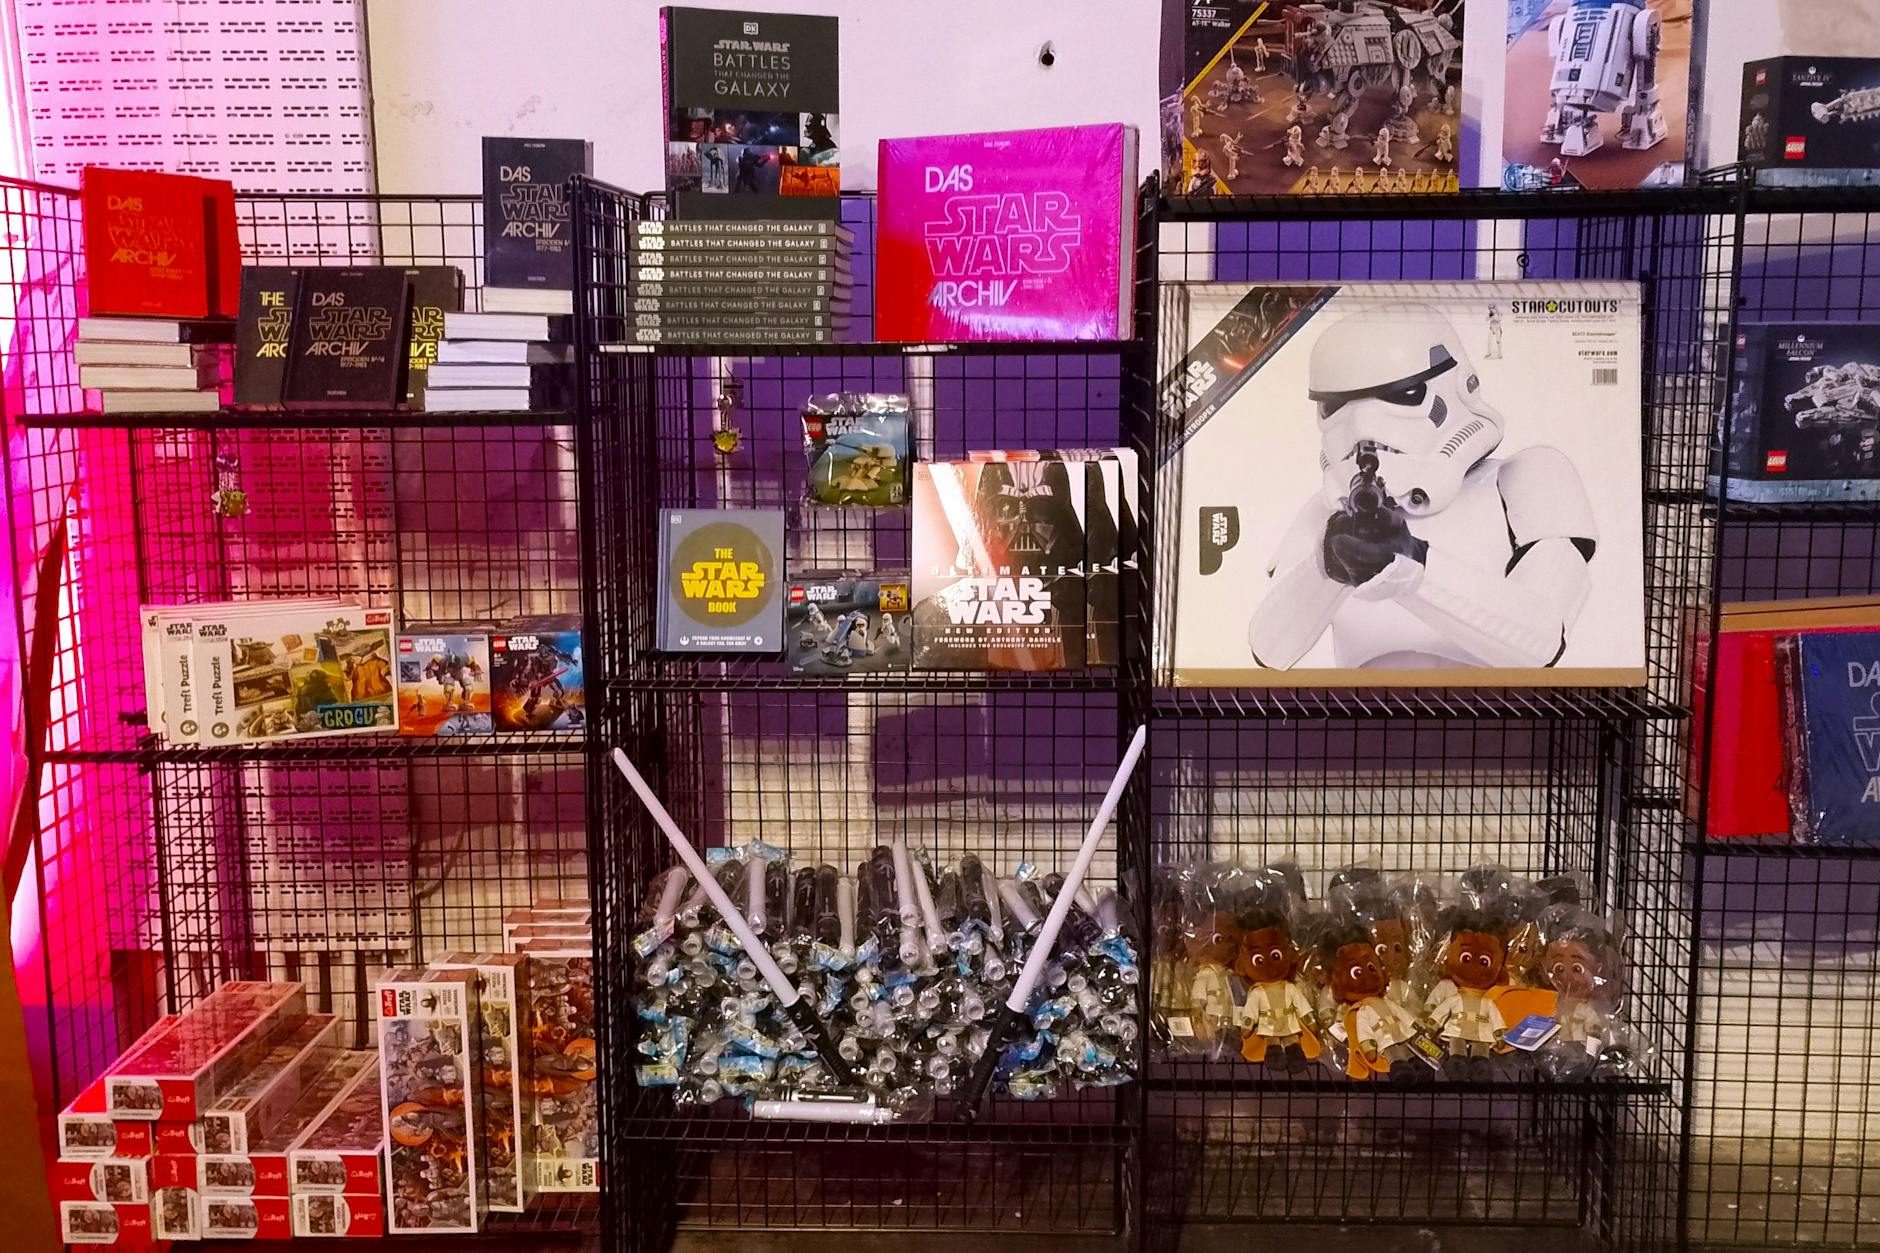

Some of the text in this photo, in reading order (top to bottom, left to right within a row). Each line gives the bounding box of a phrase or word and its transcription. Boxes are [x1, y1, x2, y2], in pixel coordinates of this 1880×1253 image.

[1192, 9, 1216, 18] 75337
[714, 40, 791, 52] STAR WARS
[714, 52, 791, 70] BATTLES
[714, 70, 733, 78] THAT
[735, 71, 773, 79] CHANGED
[714, 80, 790, 98] GALAXY
[500, 166, 531, 182] DAS
[925, 164, 973, 192] DAS
[107, 195, 142, 211] DAS
[924, 191, 1081, 236] STAR
[502, 222, 560, 238] ARCHIV
[110, 248, 176, 266] ARCHIV
[924, 232, 1081, 276] WARS
[260, 292, 285, 306] THE
[312, 292, 345, 306] DAS
[928, 279, 1018, 308] ARCHIV
[1512, 300, 1618, 313] STAR CUTOUTS
[309, 307, 392, 324] STAR
[309, 323, 391, 340] WARS
[305, 342, 369, 356] ARCHIV
[1162, 360, 1210, 401] STAR
[1162, 371, 1217, 420] WARS
[1168, 404, 1217, 452] STOMTROOPER
[1767, 456, 1786, 466] LEGO
[1212, 512, 1220, 546] WARS
[714, 548, 733, 559] THE
[681, 562, 764, 580] STAR
[682, 580, 764, 598] WARS
[806, 586, 837, 594] STAR
[806, 592, 837, 600] WARS
[949, 578, 1051, 600] STAR
[708, 602, 736, 613] BOOK
[948, 601, 1051, 624] WARS
[508, 636, 539, 644] STAR
[508, 643, 539, 651] WARS
[179, 654, 192, 713] Trefl Puzzle
[211, 656, 224, 716] Trefl Puzzle
[325, 707, 373, 727] GROGU
